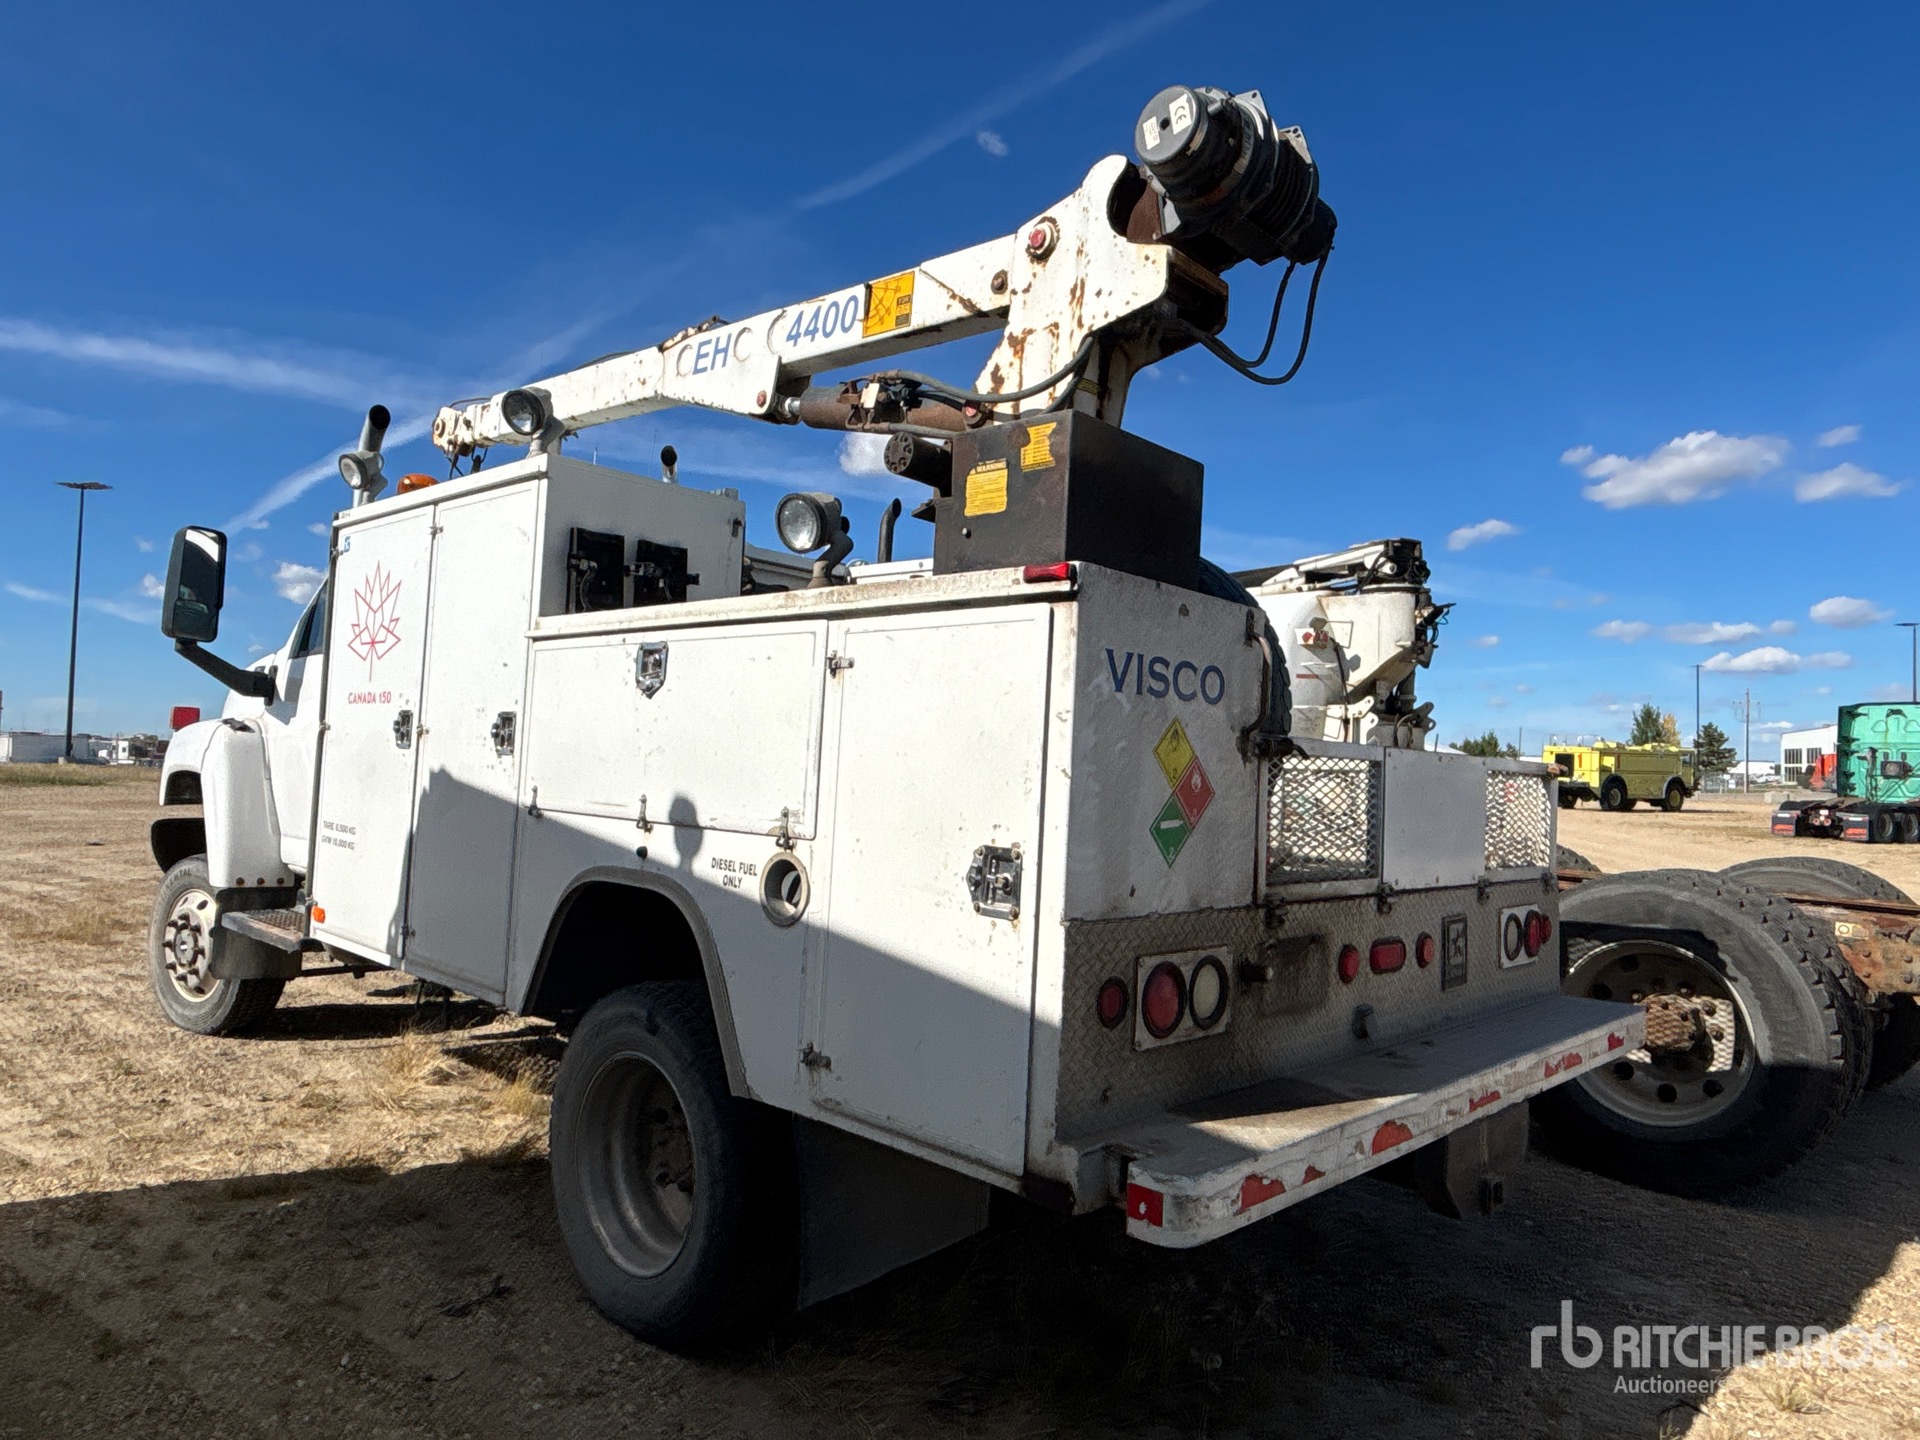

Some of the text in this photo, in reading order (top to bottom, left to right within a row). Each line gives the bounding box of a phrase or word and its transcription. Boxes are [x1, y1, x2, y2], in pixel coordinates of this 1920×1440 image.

[786, 294, 859, 348] 4400
[1105, 647, 1226, 706] VISCO
[347, 690, 392, 705] CANADA 150
[711, 857, 757, 876] DIESEL FUEL
[722, 874, 743, 889] ONLY
